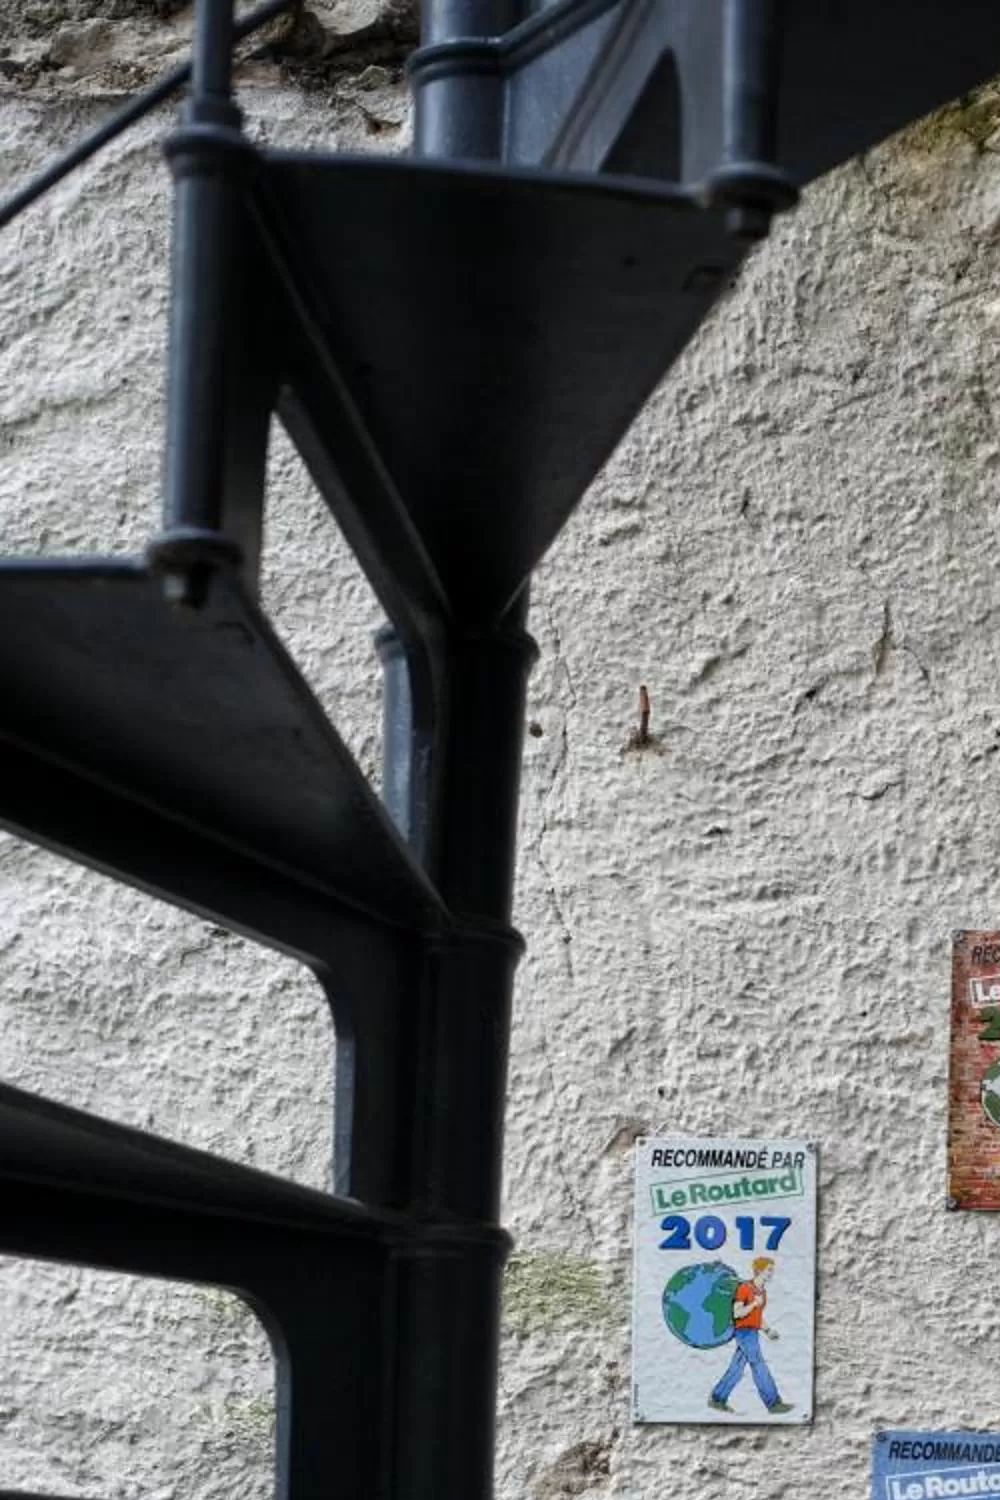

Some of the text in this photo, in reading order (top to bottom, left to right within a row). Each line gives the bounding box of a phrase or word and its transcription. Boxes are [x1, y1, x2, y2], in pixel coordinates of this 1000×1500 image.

[651, 1146, 805, 1169] RECOMMANDÉ PAR
[656, 1168, 797, 1208] Le Routard
[659, 1215, 792, 1251] 2017
